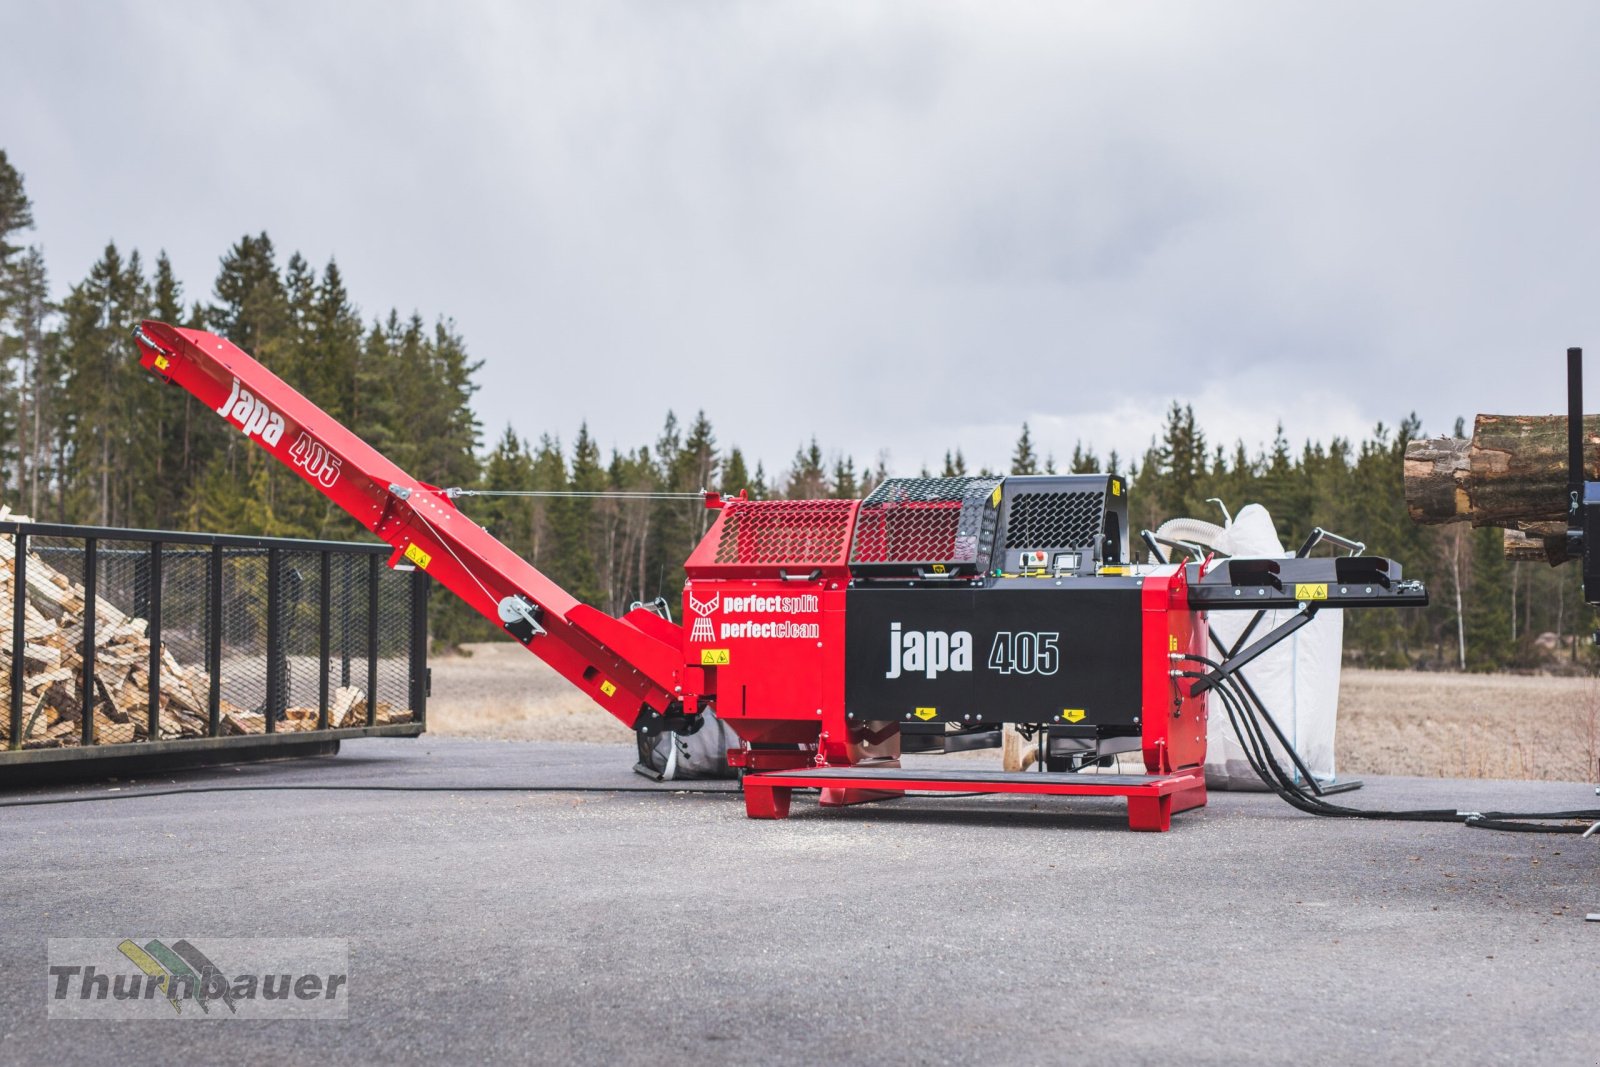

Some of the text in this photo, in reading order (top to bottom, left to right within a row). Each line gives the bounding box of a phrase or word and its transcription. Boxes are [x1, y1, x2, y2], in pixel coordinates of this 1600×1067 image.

[216, 376, 342, 488] japa 405
[723, 595, 819, 614] perfectsplit
[720, 620, 819, 639] perfectclean
[885, 622, 1059, 679] japa 405
